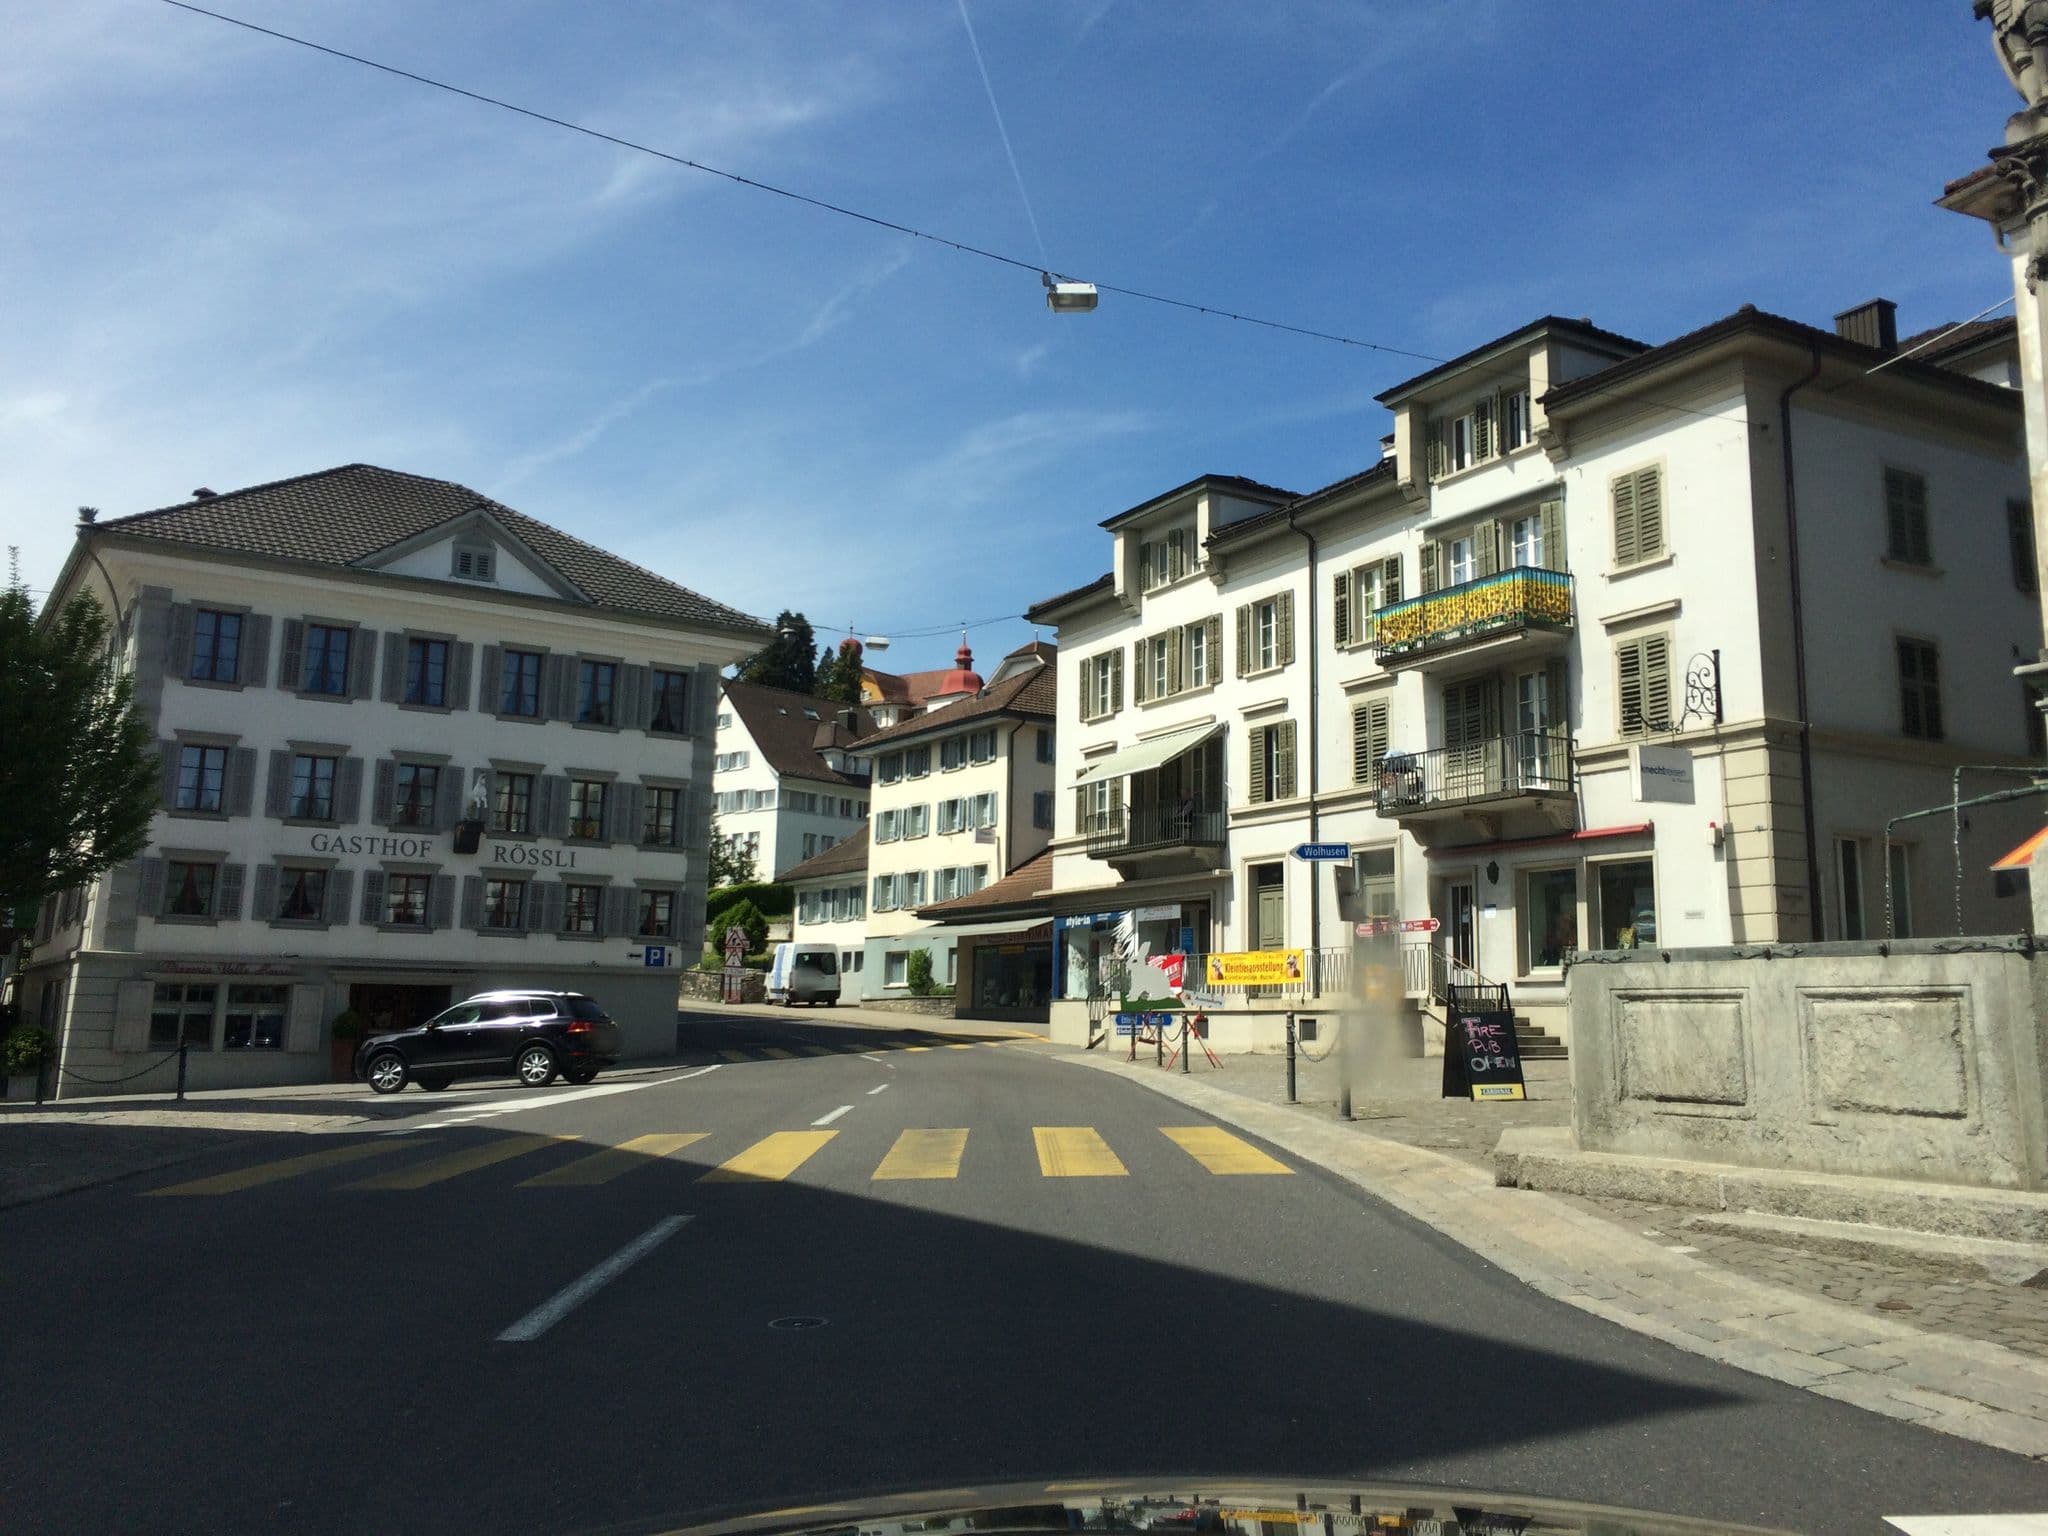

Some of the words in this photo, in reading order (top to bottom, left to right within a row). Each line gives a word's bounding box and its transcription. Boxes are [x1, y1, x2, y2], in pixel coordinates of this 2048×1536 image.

[310, 833, 433, 858] GASTHOF
[494, 843, 576, 868] RÖSSLI
[1304, 846, 1346, 857] Wolhusen
[1467, 1039, 1501, 1053] PUB
